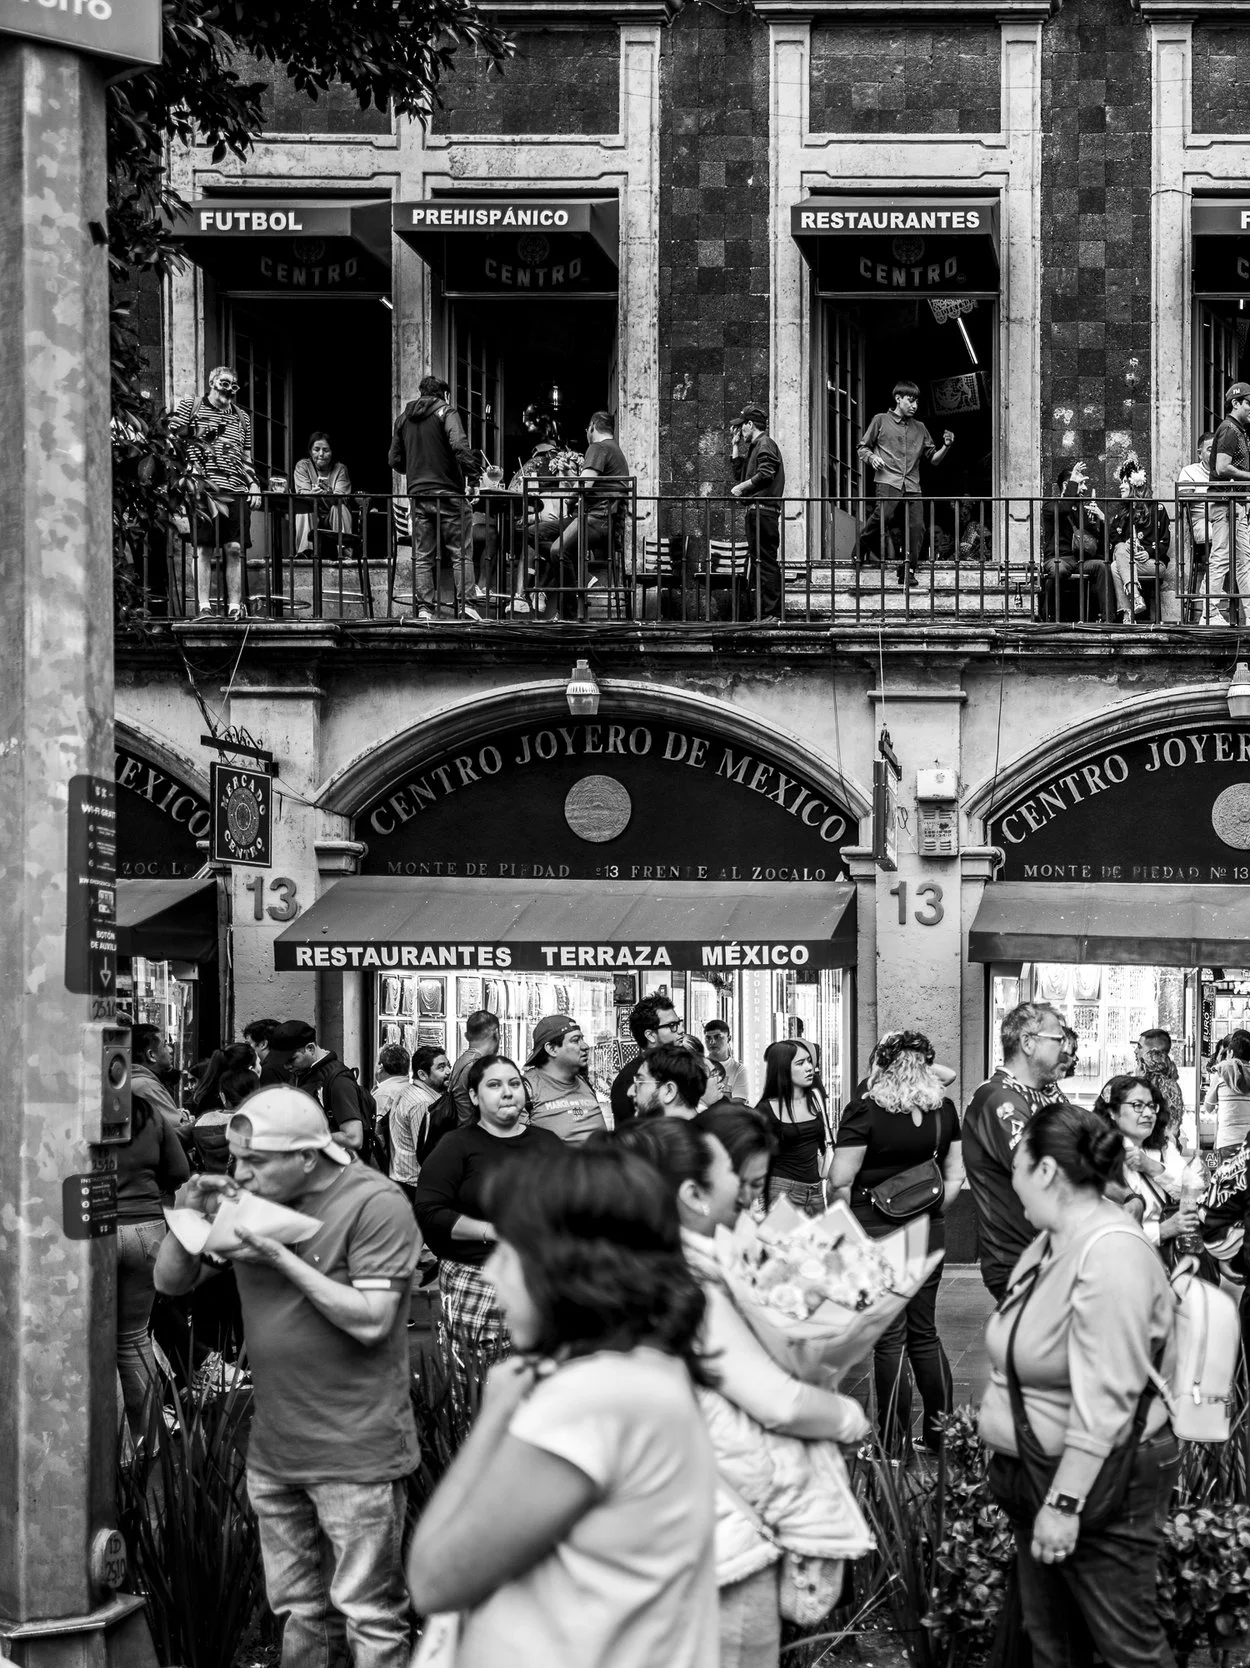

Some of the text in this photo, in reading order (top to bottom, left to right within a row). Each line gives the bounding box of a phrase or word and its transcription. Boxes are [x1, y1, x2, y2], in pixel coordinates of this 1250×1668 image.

[200, 212, 303, 231] FUTBOL
[412, 206, 569, 226] PREHISPÁNICO
[801, 211, 980, 229] RESTAURANTES
[260, 256, 358, 287] CENTRO
[485, 256, 582, 287] CENTRO
[859, 255, 958, 287] CENTRO
[115, 752, 210, 837] EXICO
[220, 774, 266, 816] MERCADO
[369, 725, 848, 844] CENTRO JOYERO DE MEXICO
[1001, 754, 1130, 845] CENTRO
[122, 862, 196, 875] ZOCL
[387, 861, 457, 875] MONTE
[466, 863, 488, 875] DE
[631, 865, 708, 879] FRENE
[752, 867, 826, 881] ZOCALO
[1024, 864, 1091, 878] MONTE
[1102, 865, 1121, 879] DE
[1133, 865, 1199, 879] PIEDAD
[1233, 867, 1249, 879] 13
[247, 876, 300, 921] 13
[890, 881, 945, 926] 13
[296, 941, 809, 967] RESTAURANTES TERRAZA MÉXICO
